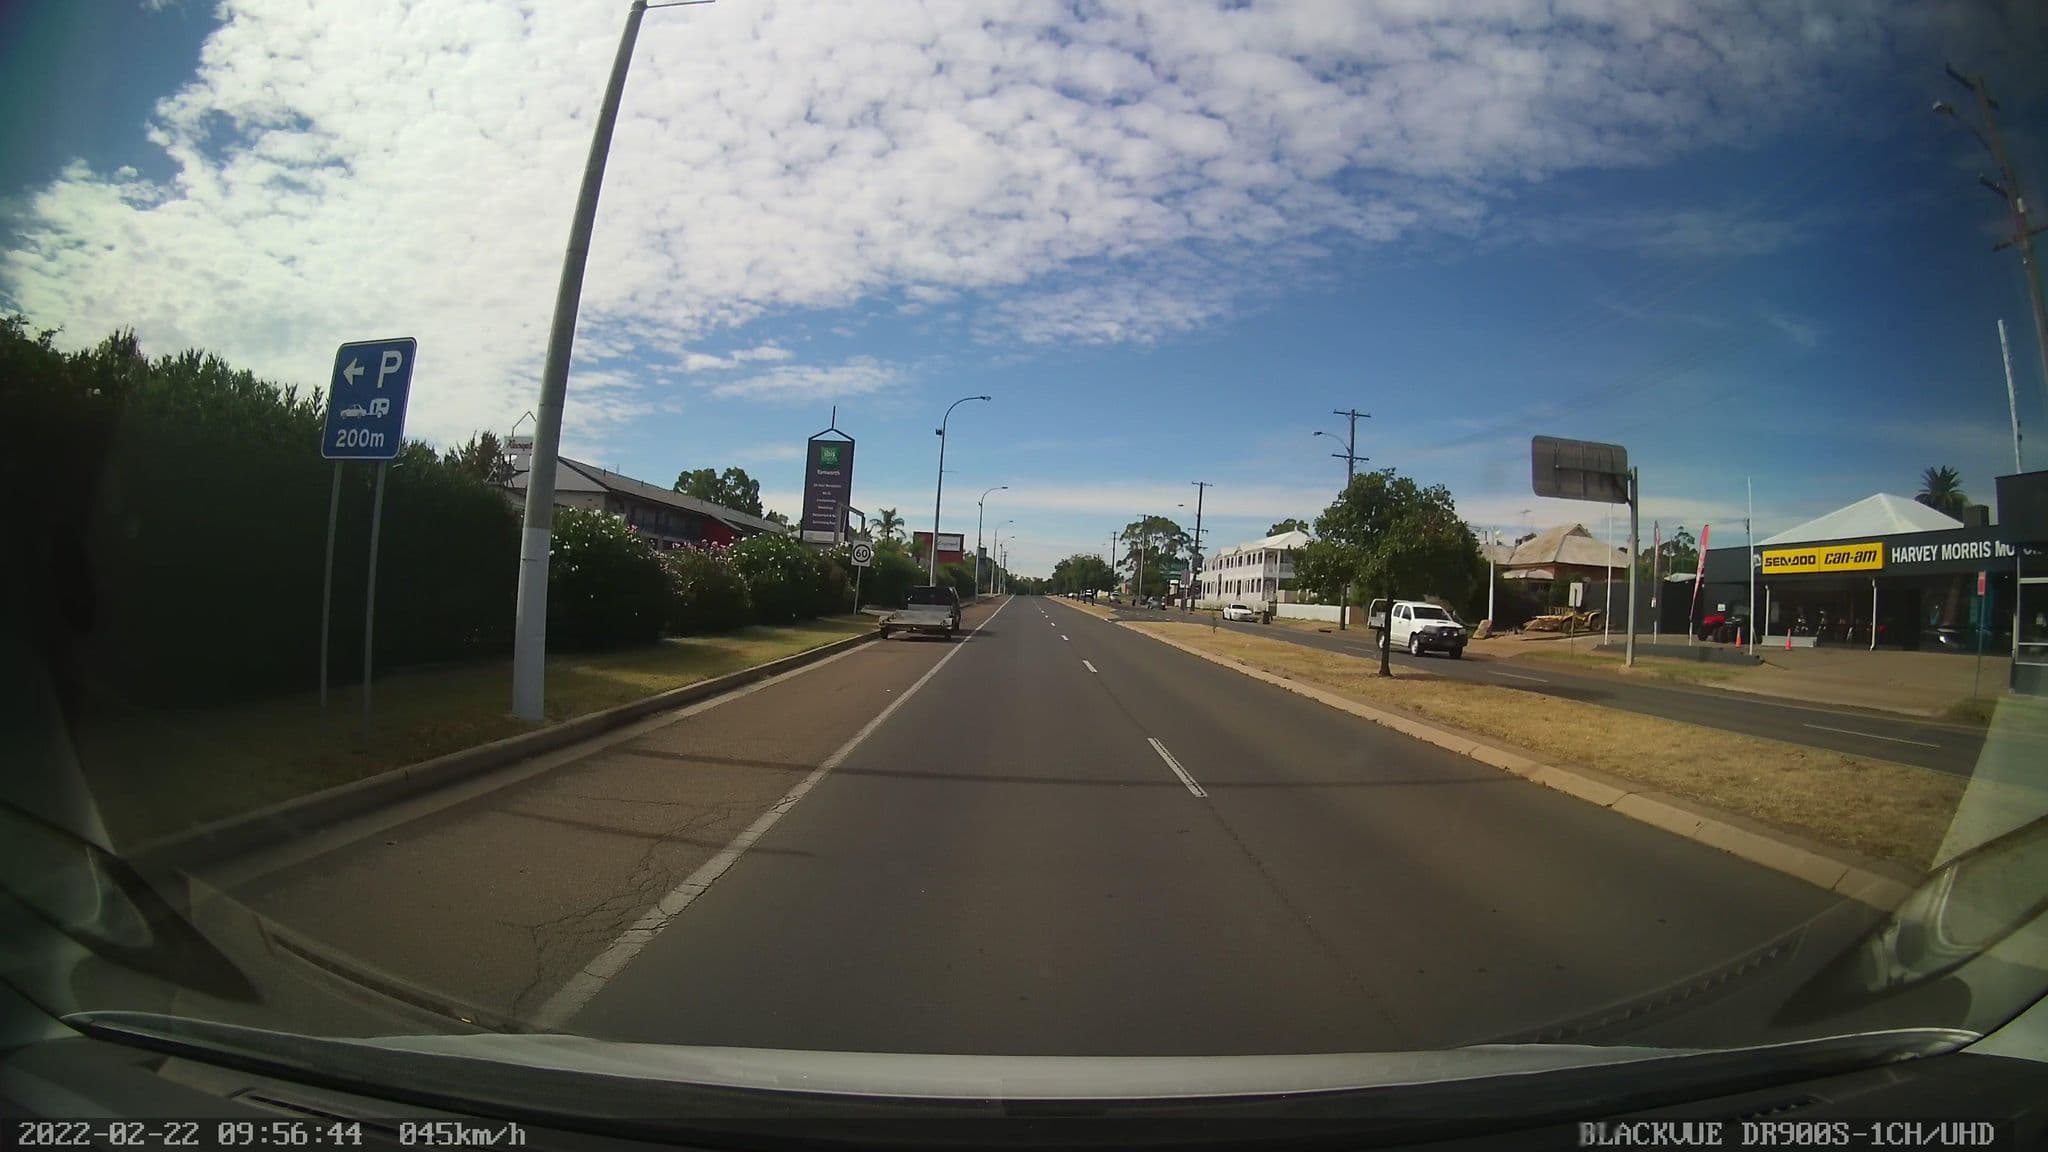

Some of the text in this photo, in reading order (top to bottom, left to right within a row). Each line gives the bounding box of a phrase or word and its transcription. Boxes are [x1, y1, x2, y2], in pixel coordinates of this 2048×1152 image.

[377, 350, 403, 389] P
[335, 428, 385, 448] 200m
[855, 549, 868, 558] 60
[1891, 545, 1938, 564] HARVEY
[1941, 541, 1991, 561] MORRIS
